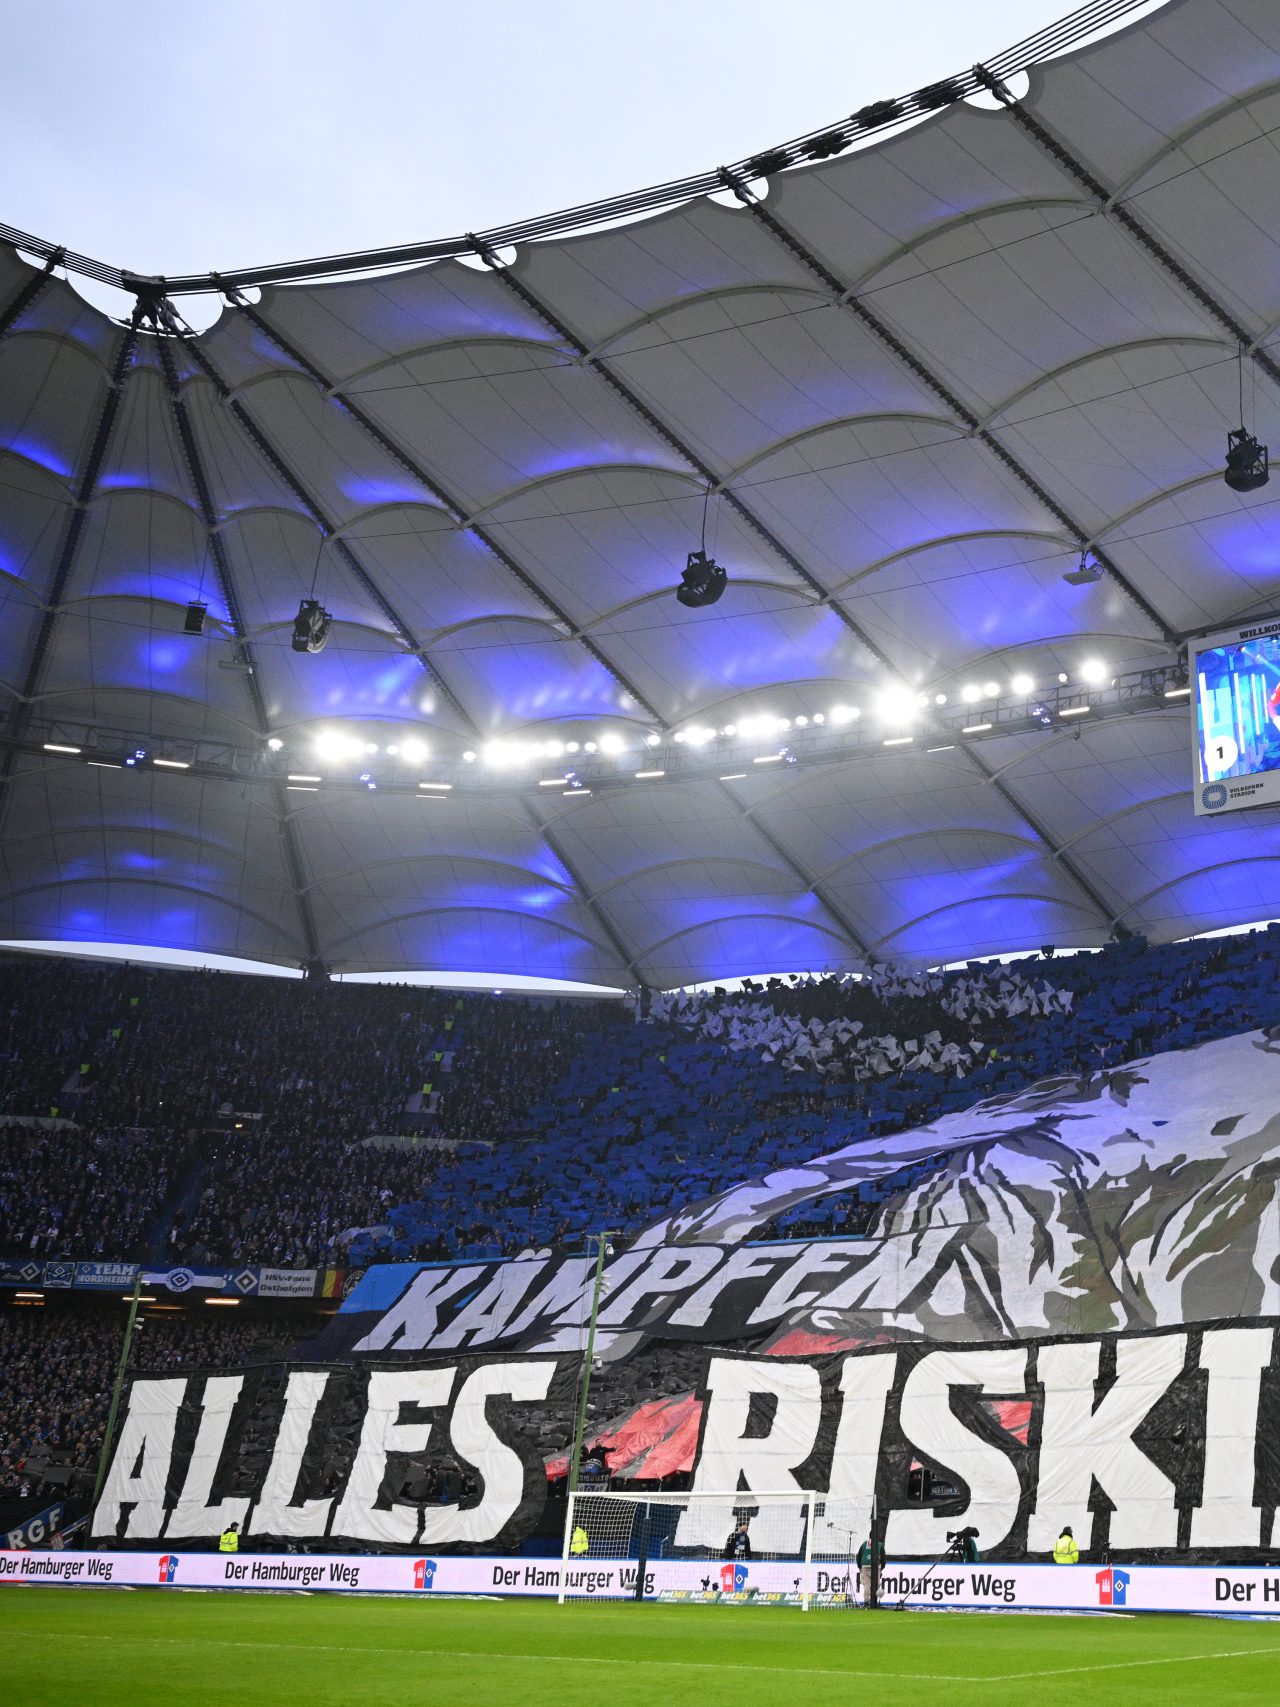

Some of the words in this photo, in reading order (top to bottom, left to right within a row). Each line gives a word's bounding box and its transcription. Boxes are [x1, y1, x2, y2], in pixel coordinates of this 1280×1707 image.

[1216, 746, 1224, 759] 1
[1229, 782, 1264, 793] VOLKSPARK
[1230, 790, 1256, 799] STADION
[94, 1264, 136, 1276] TEAM
[77, 1275, 133, 1284] NORDHEIDE
[352, 1225, 962, 1352] KÄMPFEN
[90, 1360, 559, 1546] ALLES
[0, 1557, 19, 1574] Der
[20, 1557, 85, 1579] Hamburger
[87, 1559, 114, 1580] Weg
[224, 1561, 249, 1579] Der
[251, 1561, 325, 1586] Hamburger
[329, 1563, 360, 1587] Weg
[492, 1566, 521, 1586] Der
[619, 1568, 656, 1594] Wg
[816, 1571, 848, 1593] Der
[971, 1574, 1016, 1602] Weg
[1215, 1577, 1256, 1602] Der
[659, 1590, 686, 1599] bet365
[690, 1591, 717, 1600] bet365
[720, 1592, 749, 1601] bet365
[752, 1592, 781, 1601] bet365
